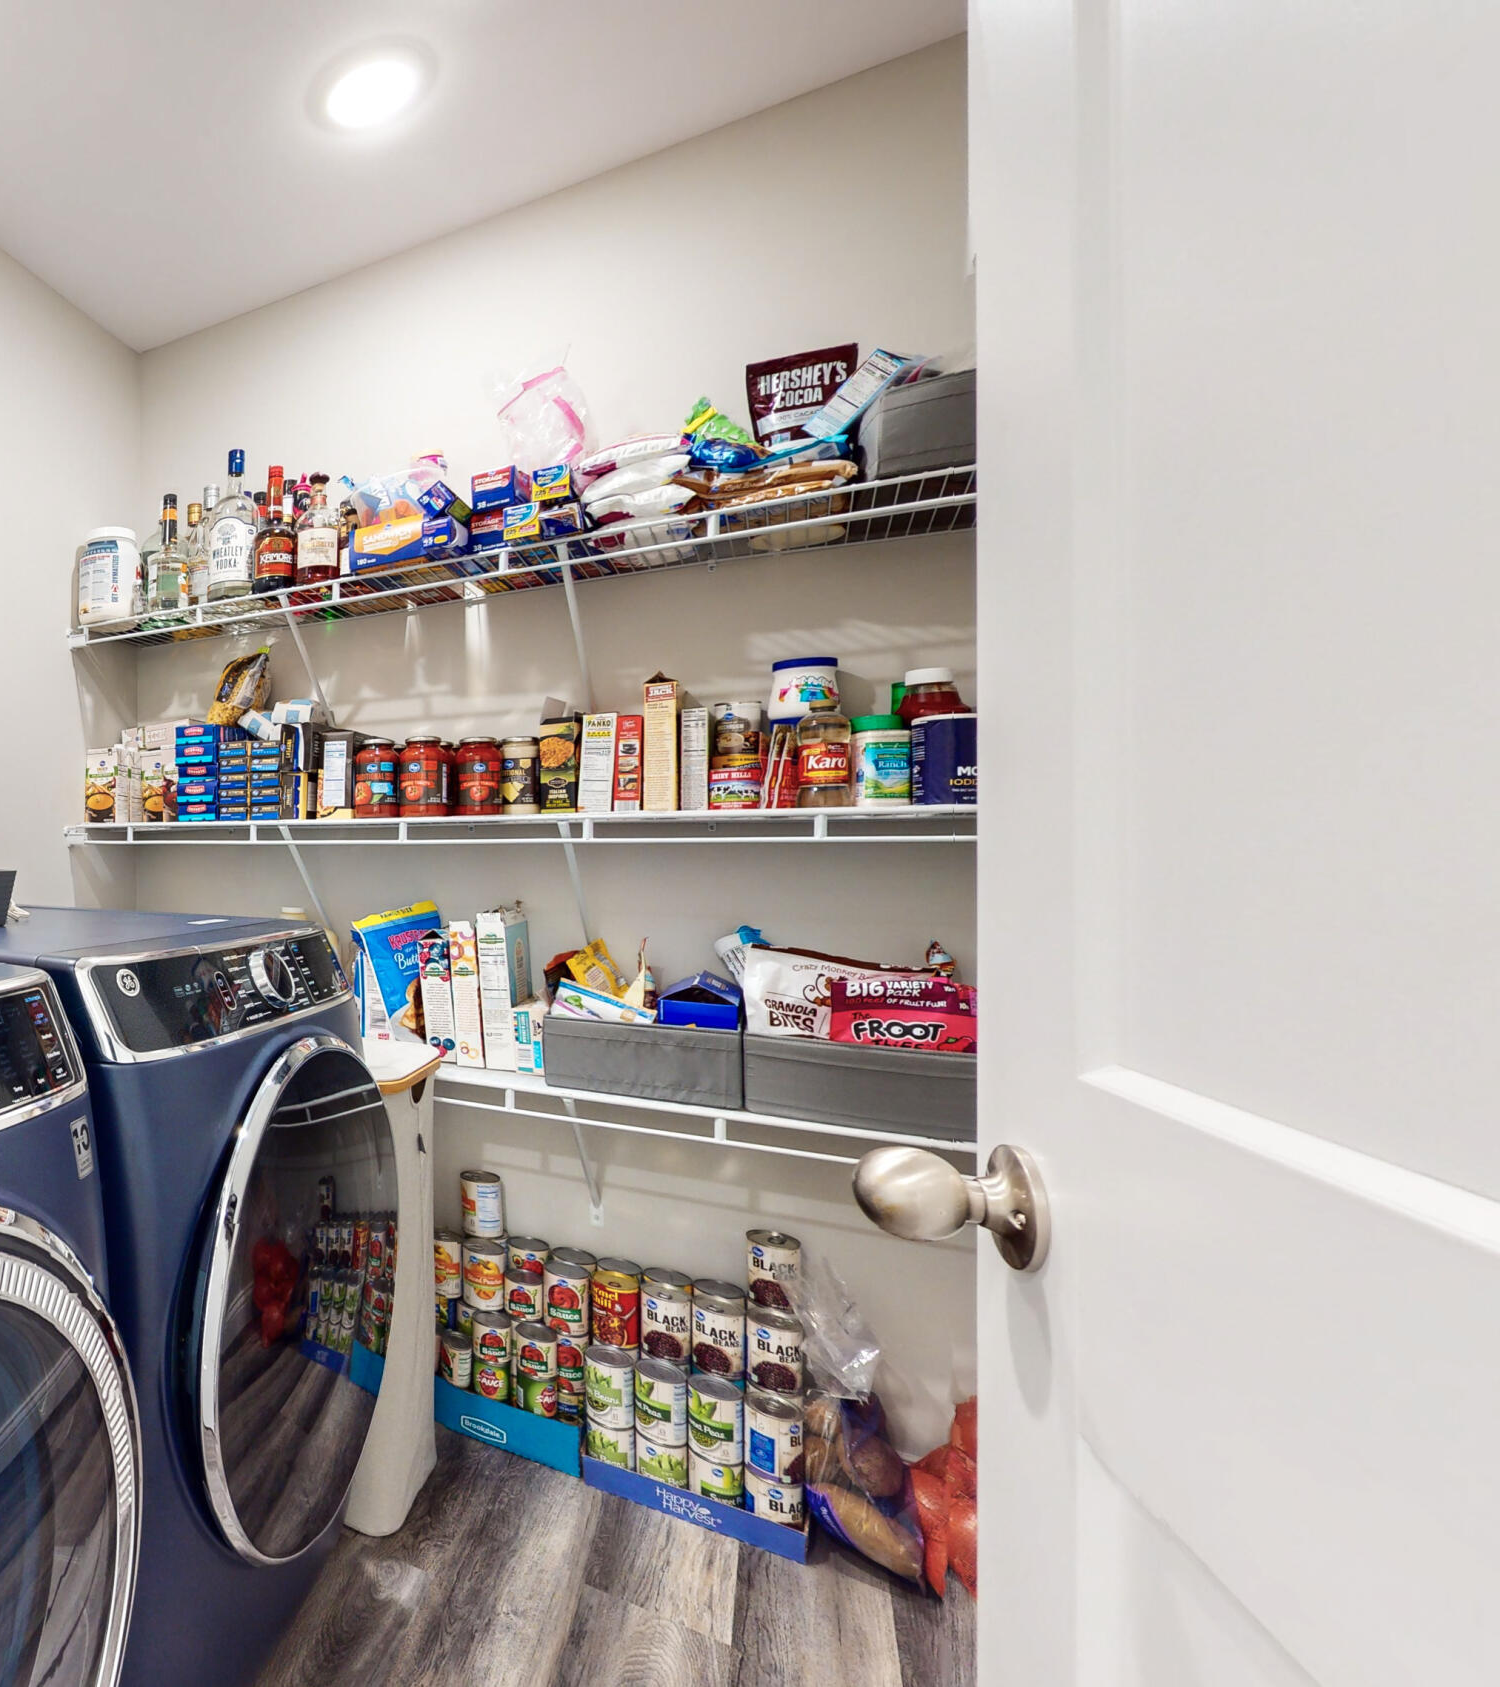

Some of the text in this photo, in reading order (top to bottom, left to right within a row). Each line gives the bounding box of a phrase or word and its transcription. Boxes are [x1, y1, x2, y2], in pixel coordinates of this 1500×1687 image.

[759, 361, 847, 396] HERSHEY'S
[774, 387, 823, 409] COCOA
[216, 559, 237, 571] VODKA
[648, 687, 674, 697] JACK
[587, 719, 612, 728] PANKO
[807, 755, 847, 770] Karo
[878, 760, 907, 768] Ranch
[394, 952, 419, 970] Butt
[845, 981, 884, 997] BIG
[885, 981, 934, 990] VARIETY
[764, 999, 818, 1017] GRANOLA
[853, 1021, 946, 1041] FROOT
[752, 1256, 795, 1273] BLACK
[593, 1286, 618, 1301] rmel
[510, 1305, 534, 1313] Sauce
[593, 1294, 611, 1309] hili
[549, 1308, 580, 1321] Sauce
[647, 1309, 687, 1326] BLACK
[695, 1320, 736, 1341] BLACK
[712, 1337, 740, 1348] BEANS
[482, 1347, 506, 1356] Sauce
[521, 1360, 546, 1371] Sauce
[557, 1369, 583, 1378] auce
[594, 1389, 620, 1405] Beans
[641, 1405, 662, 1418] Peas
[704, 1426, 725, 1439] Peas
[656, 1486, 699, 1513] Happy
[663, 1499, 717, 1528] Harvest
